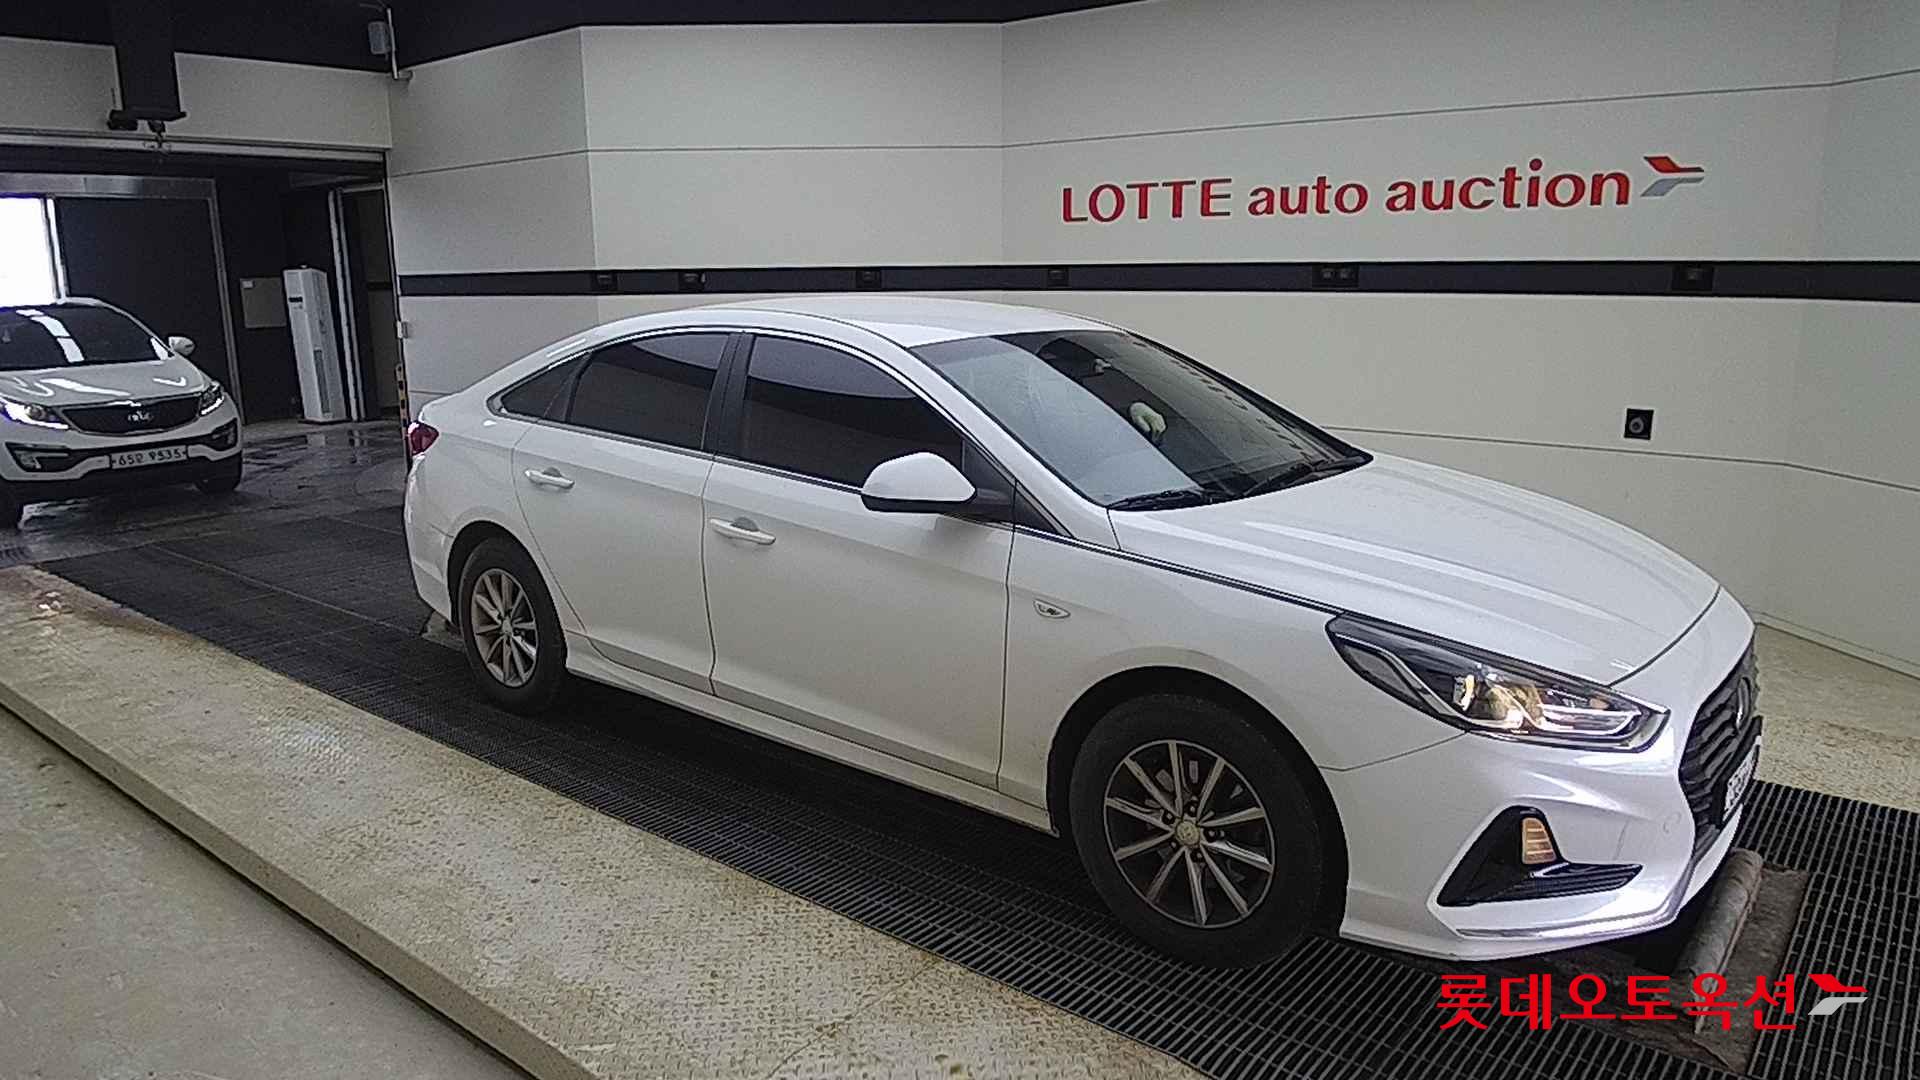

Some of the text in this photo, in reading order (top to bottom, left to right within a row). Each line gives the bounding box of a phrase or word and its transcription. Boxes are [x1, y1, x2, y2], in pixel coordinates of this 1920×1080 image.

[1061, 158, 1632, 223] LOTTE auto auction
